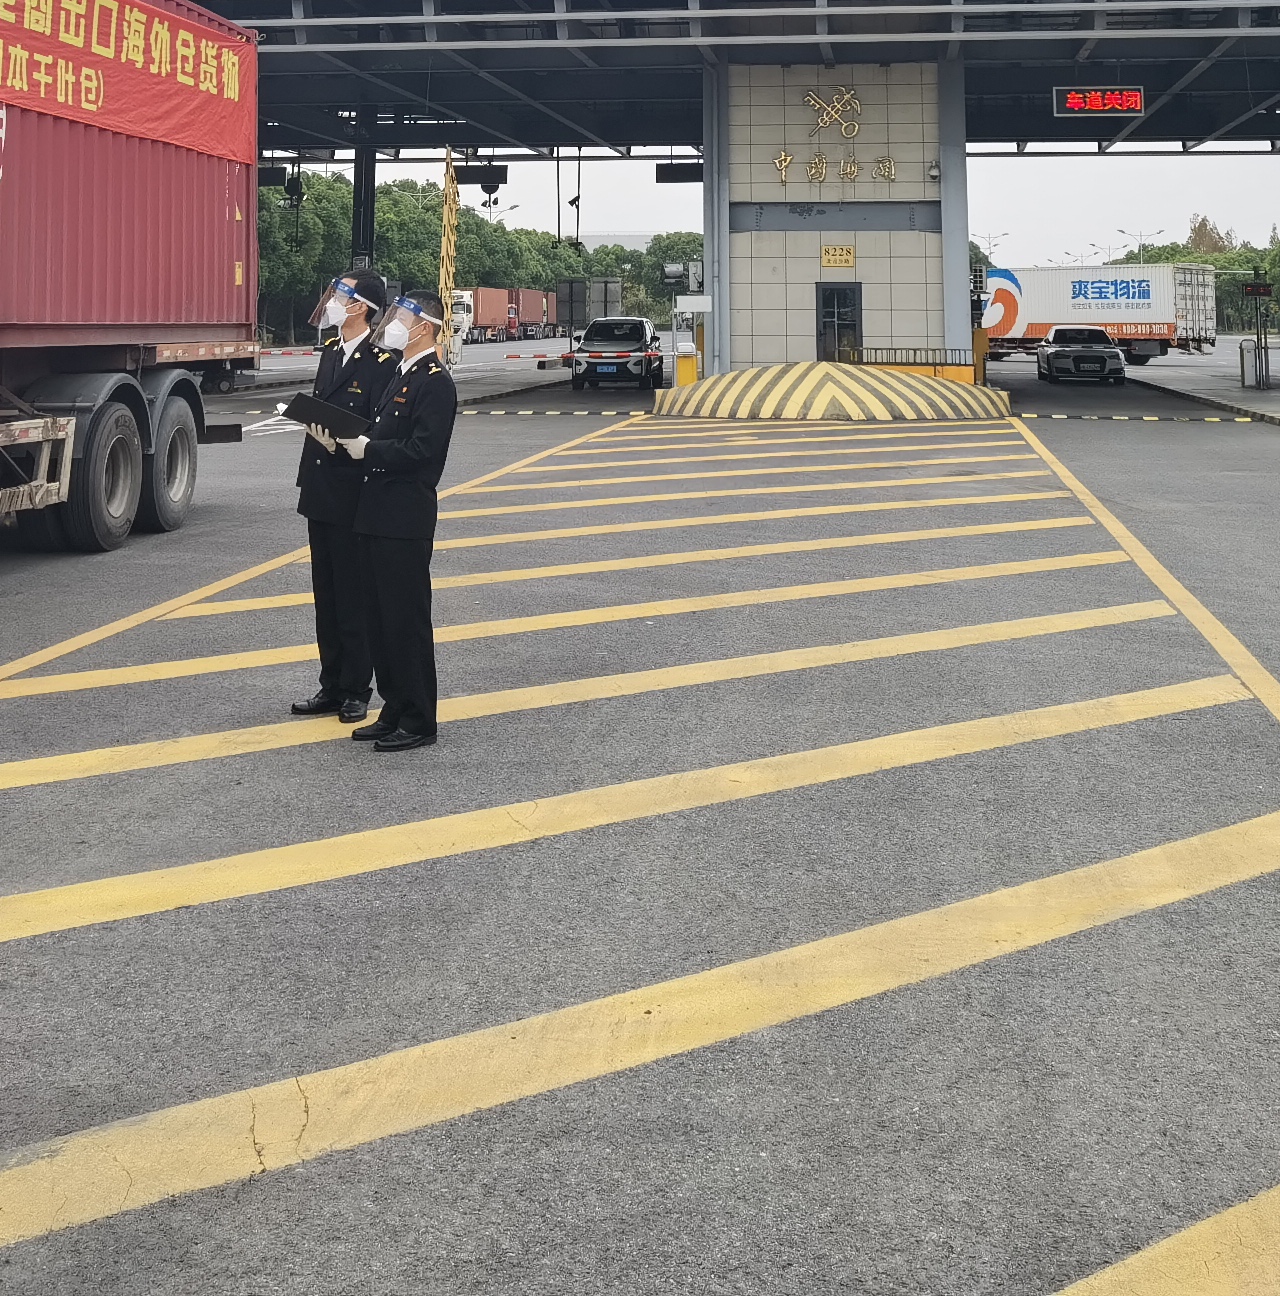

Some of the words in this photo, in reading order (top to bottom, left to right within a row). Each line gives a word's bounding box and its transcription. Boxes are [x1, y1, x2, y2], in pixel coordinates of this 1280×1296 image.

[1065, 91, 1142, 110] 车道关闭
[824, 247, 852, 257] 8228
[1070, 279, 1151, 300] 爽宝物流
